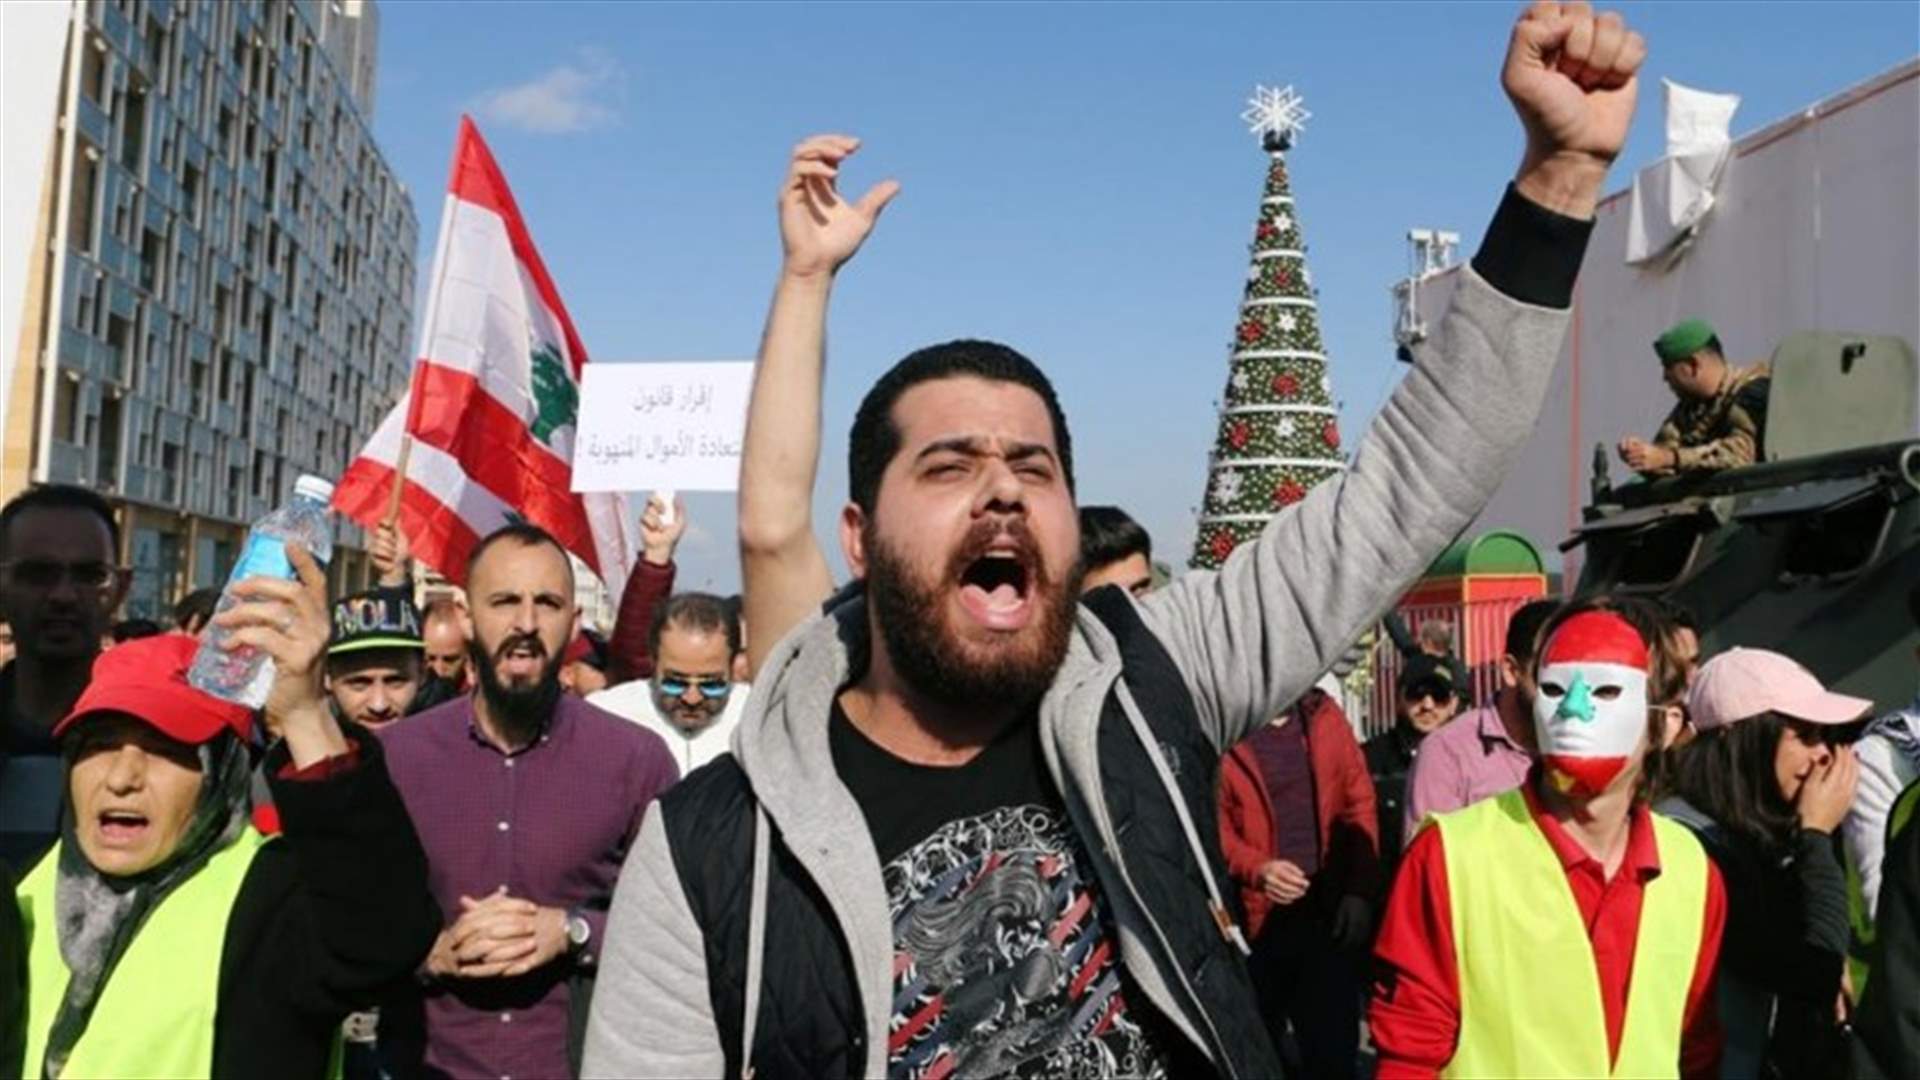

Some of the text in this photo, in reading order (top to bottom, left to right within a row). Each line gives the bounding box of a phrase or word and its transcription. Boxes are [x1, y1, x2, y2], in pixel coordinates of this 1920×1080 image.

[632, 384, 674, 414] قانون
[698, 432, 740, 458] تعادة
[334, 599, 419, 639] NOLA
